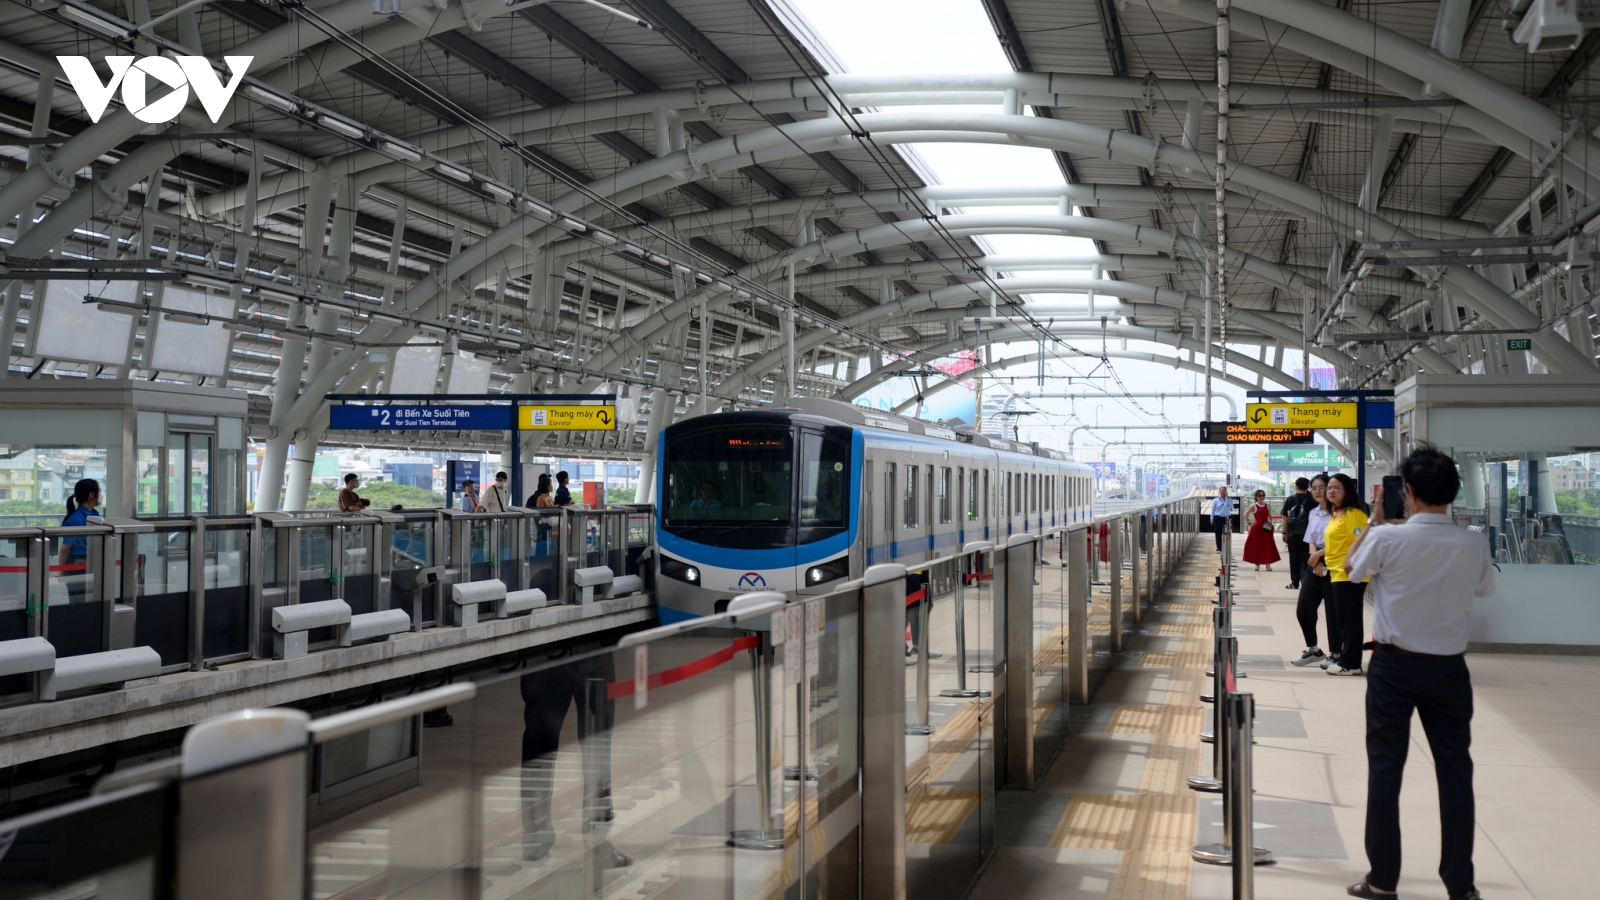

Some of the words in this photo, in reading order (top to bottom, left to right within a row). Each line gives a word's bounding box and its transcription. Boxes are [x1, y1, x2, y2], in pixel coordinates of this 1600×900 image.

[1510, 340, 1528, 349] EXIT
[395, 410, 403, 418] đi
[405, 409, 420, 418] Bến
[421, 410, 432, 418] Xe
[434, 409, 451, 418] Suối
[453, 409, 470, 418] Tiên
[549, 410, 574, 419] Thang
[576, 410, 594, 419] máy
[1291, 407, 1319, 417] Thang
[1322, 407, 1342, 417] máy
[380, 409, 390, 425] 2
[1202, 428, 1208, 438] 1
[1292, 429, 1310, 437] 13:17
